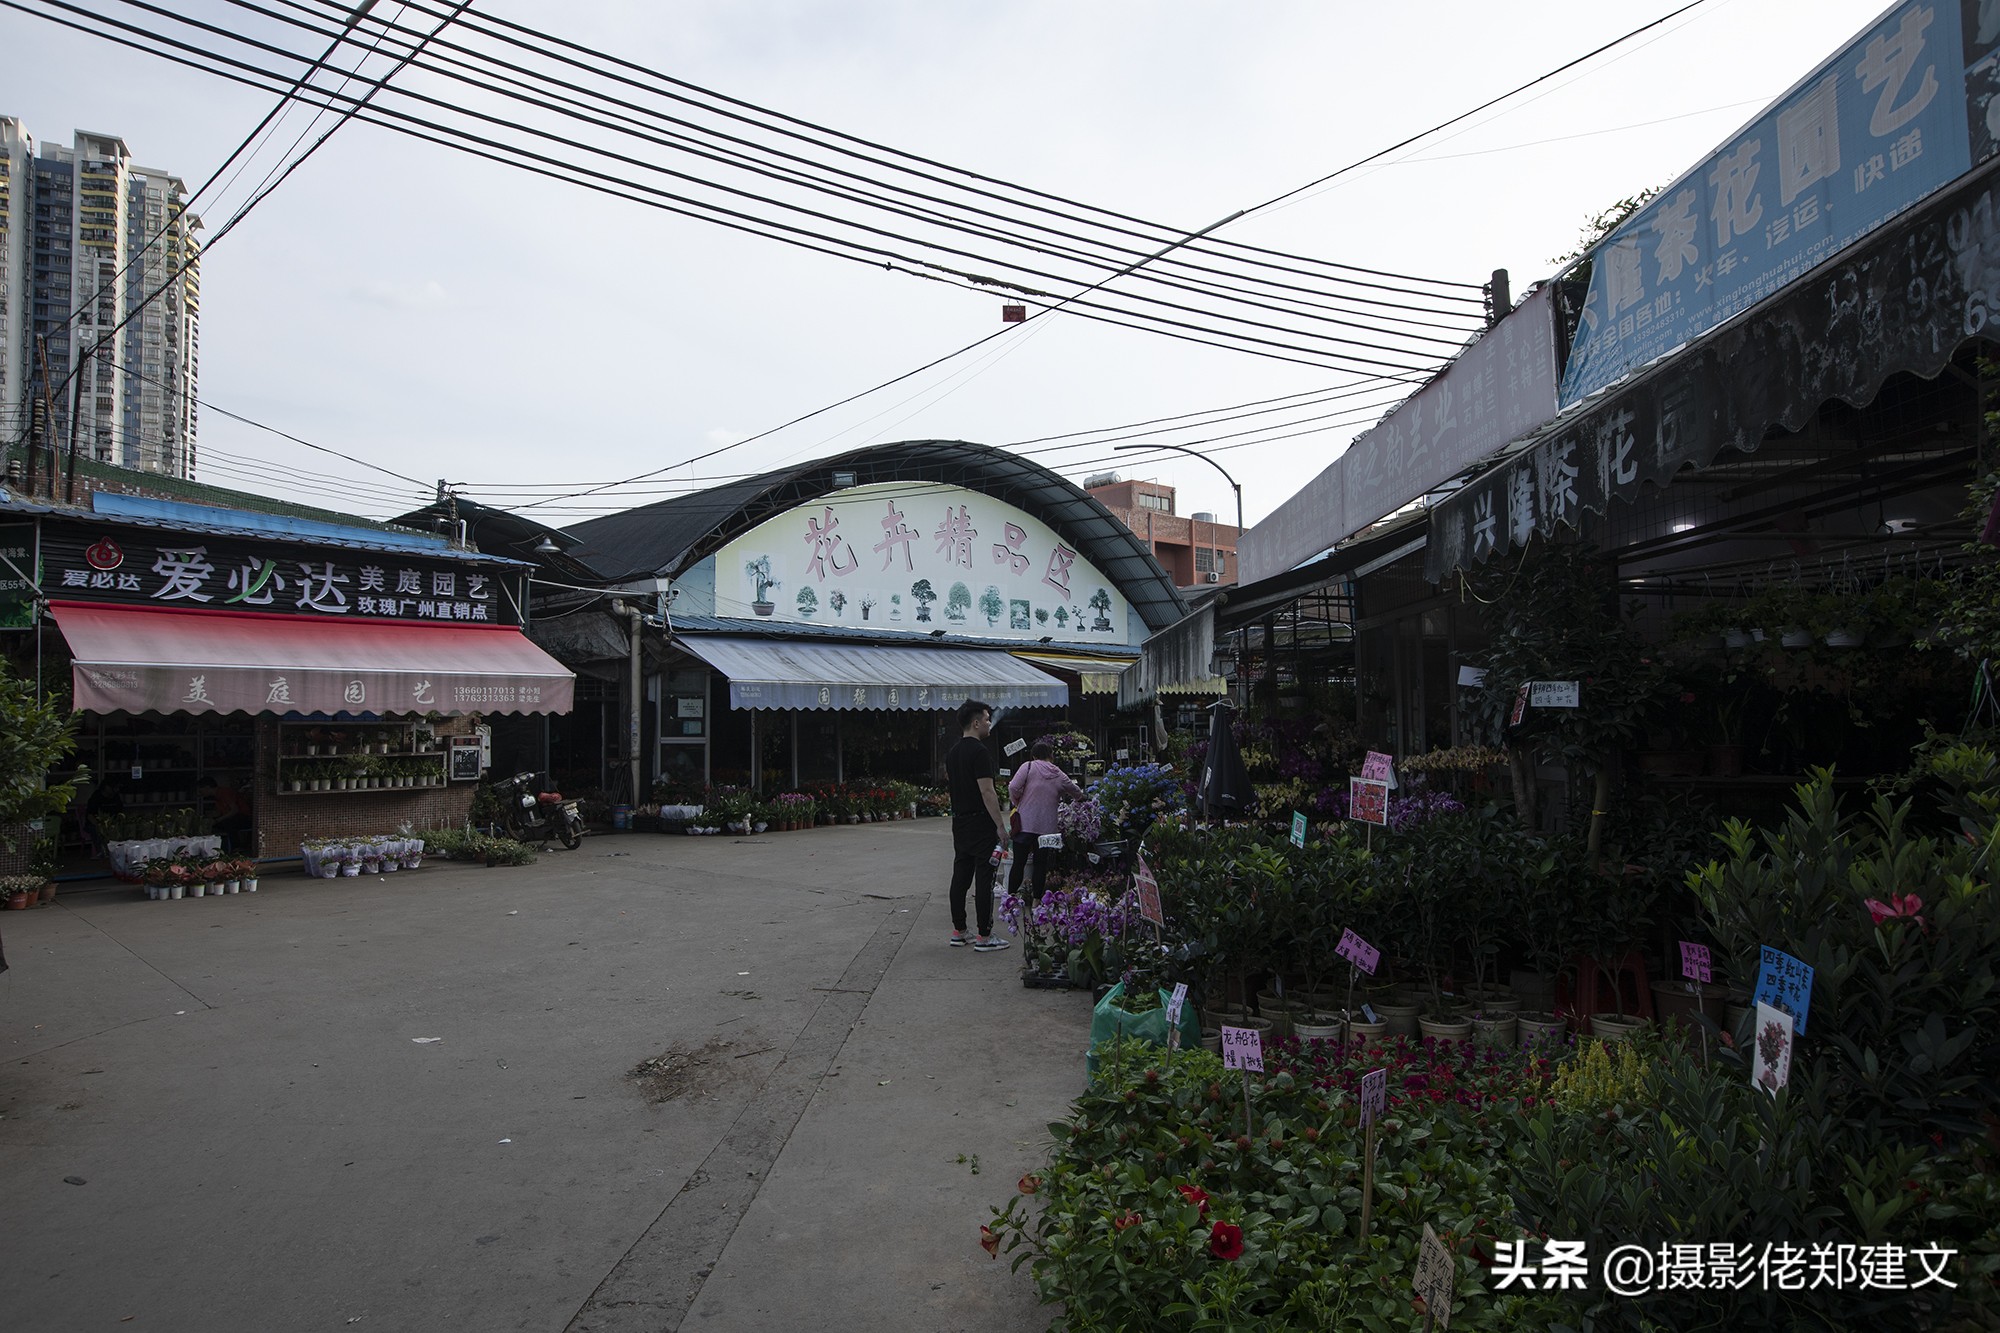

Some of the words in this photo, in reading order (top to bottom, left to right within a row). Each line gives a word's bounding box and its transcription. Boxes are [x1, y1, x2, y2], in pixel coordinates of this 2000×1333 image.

[1854, 127, 1923, 195] 快递
[1687, 233, 1835, 325] www.xinglonghuahui.com
[804, 500, 1077, 602] 花卉精品区
[61, 568, 142, 591] 爱必达
[150, 544, 351, 614] 爱必达
[357, 565, 490, 600] 美庭园艺
[357, 596, 489, 620] 玫瑰广州直销点
[182, 674, 435, 707] 美庭园艺
[453, 686, 516, 695] 13660117013
[453, 694, 516, 703] 13763313363
[1337, 945, 1350, 958] 大量
[1343, 931, 1372, 956] 鸡冠花
[1762, 948, 1810, 990] 四季红山茶
[1766, 973, 1801, 1002] 四季开花
[1223, 1029, 1259, 1048] 龙船花
[1225, 1049, 1237, 1067] 大量
